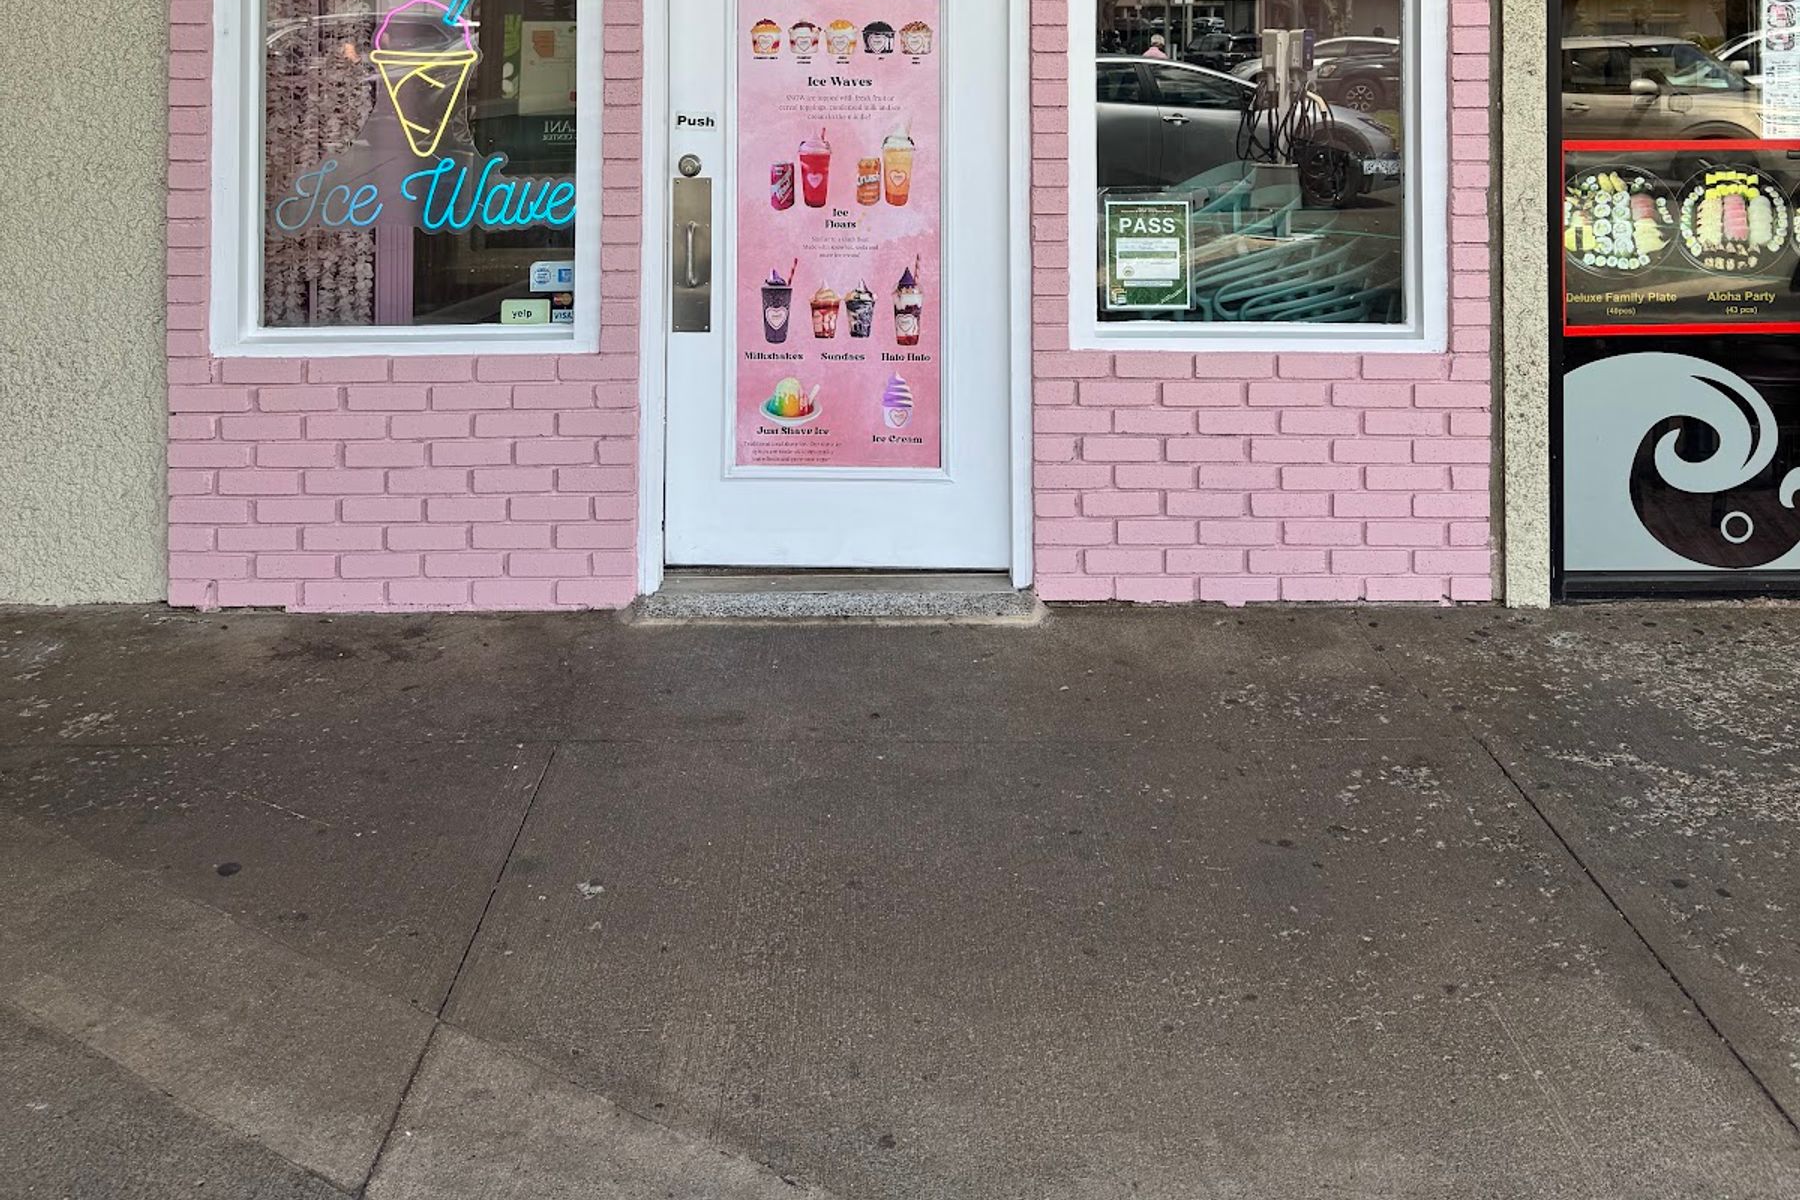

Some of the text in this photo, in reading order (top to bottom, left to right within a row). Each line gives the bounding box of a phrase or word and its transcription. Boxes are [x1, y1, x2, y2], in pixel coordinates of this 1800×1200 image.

[808, 76, 873, 87] Ice Waves
[677, 115, 715, 128] Push
[275, 157, 577, 231] Ice Wave
[832, 208, 849, 217] Ice
[825, 219, 857, 229] Floats
[1119, 217, 1176, 234] PASS
[1566, 292, 1677, 304] Deluxe Family Plate
[1707, 292, 1776, 304] Aloha Party
[511, 309, 533, 319] yelp
[744, 351, 804, 361] Milkshakes
[820, 352, 865, 361] Sundaes
[756, 426, 779, 435] Just
[781, 426, 814, 435] Shave
[871, 434, 923, 444] Ice Cream
